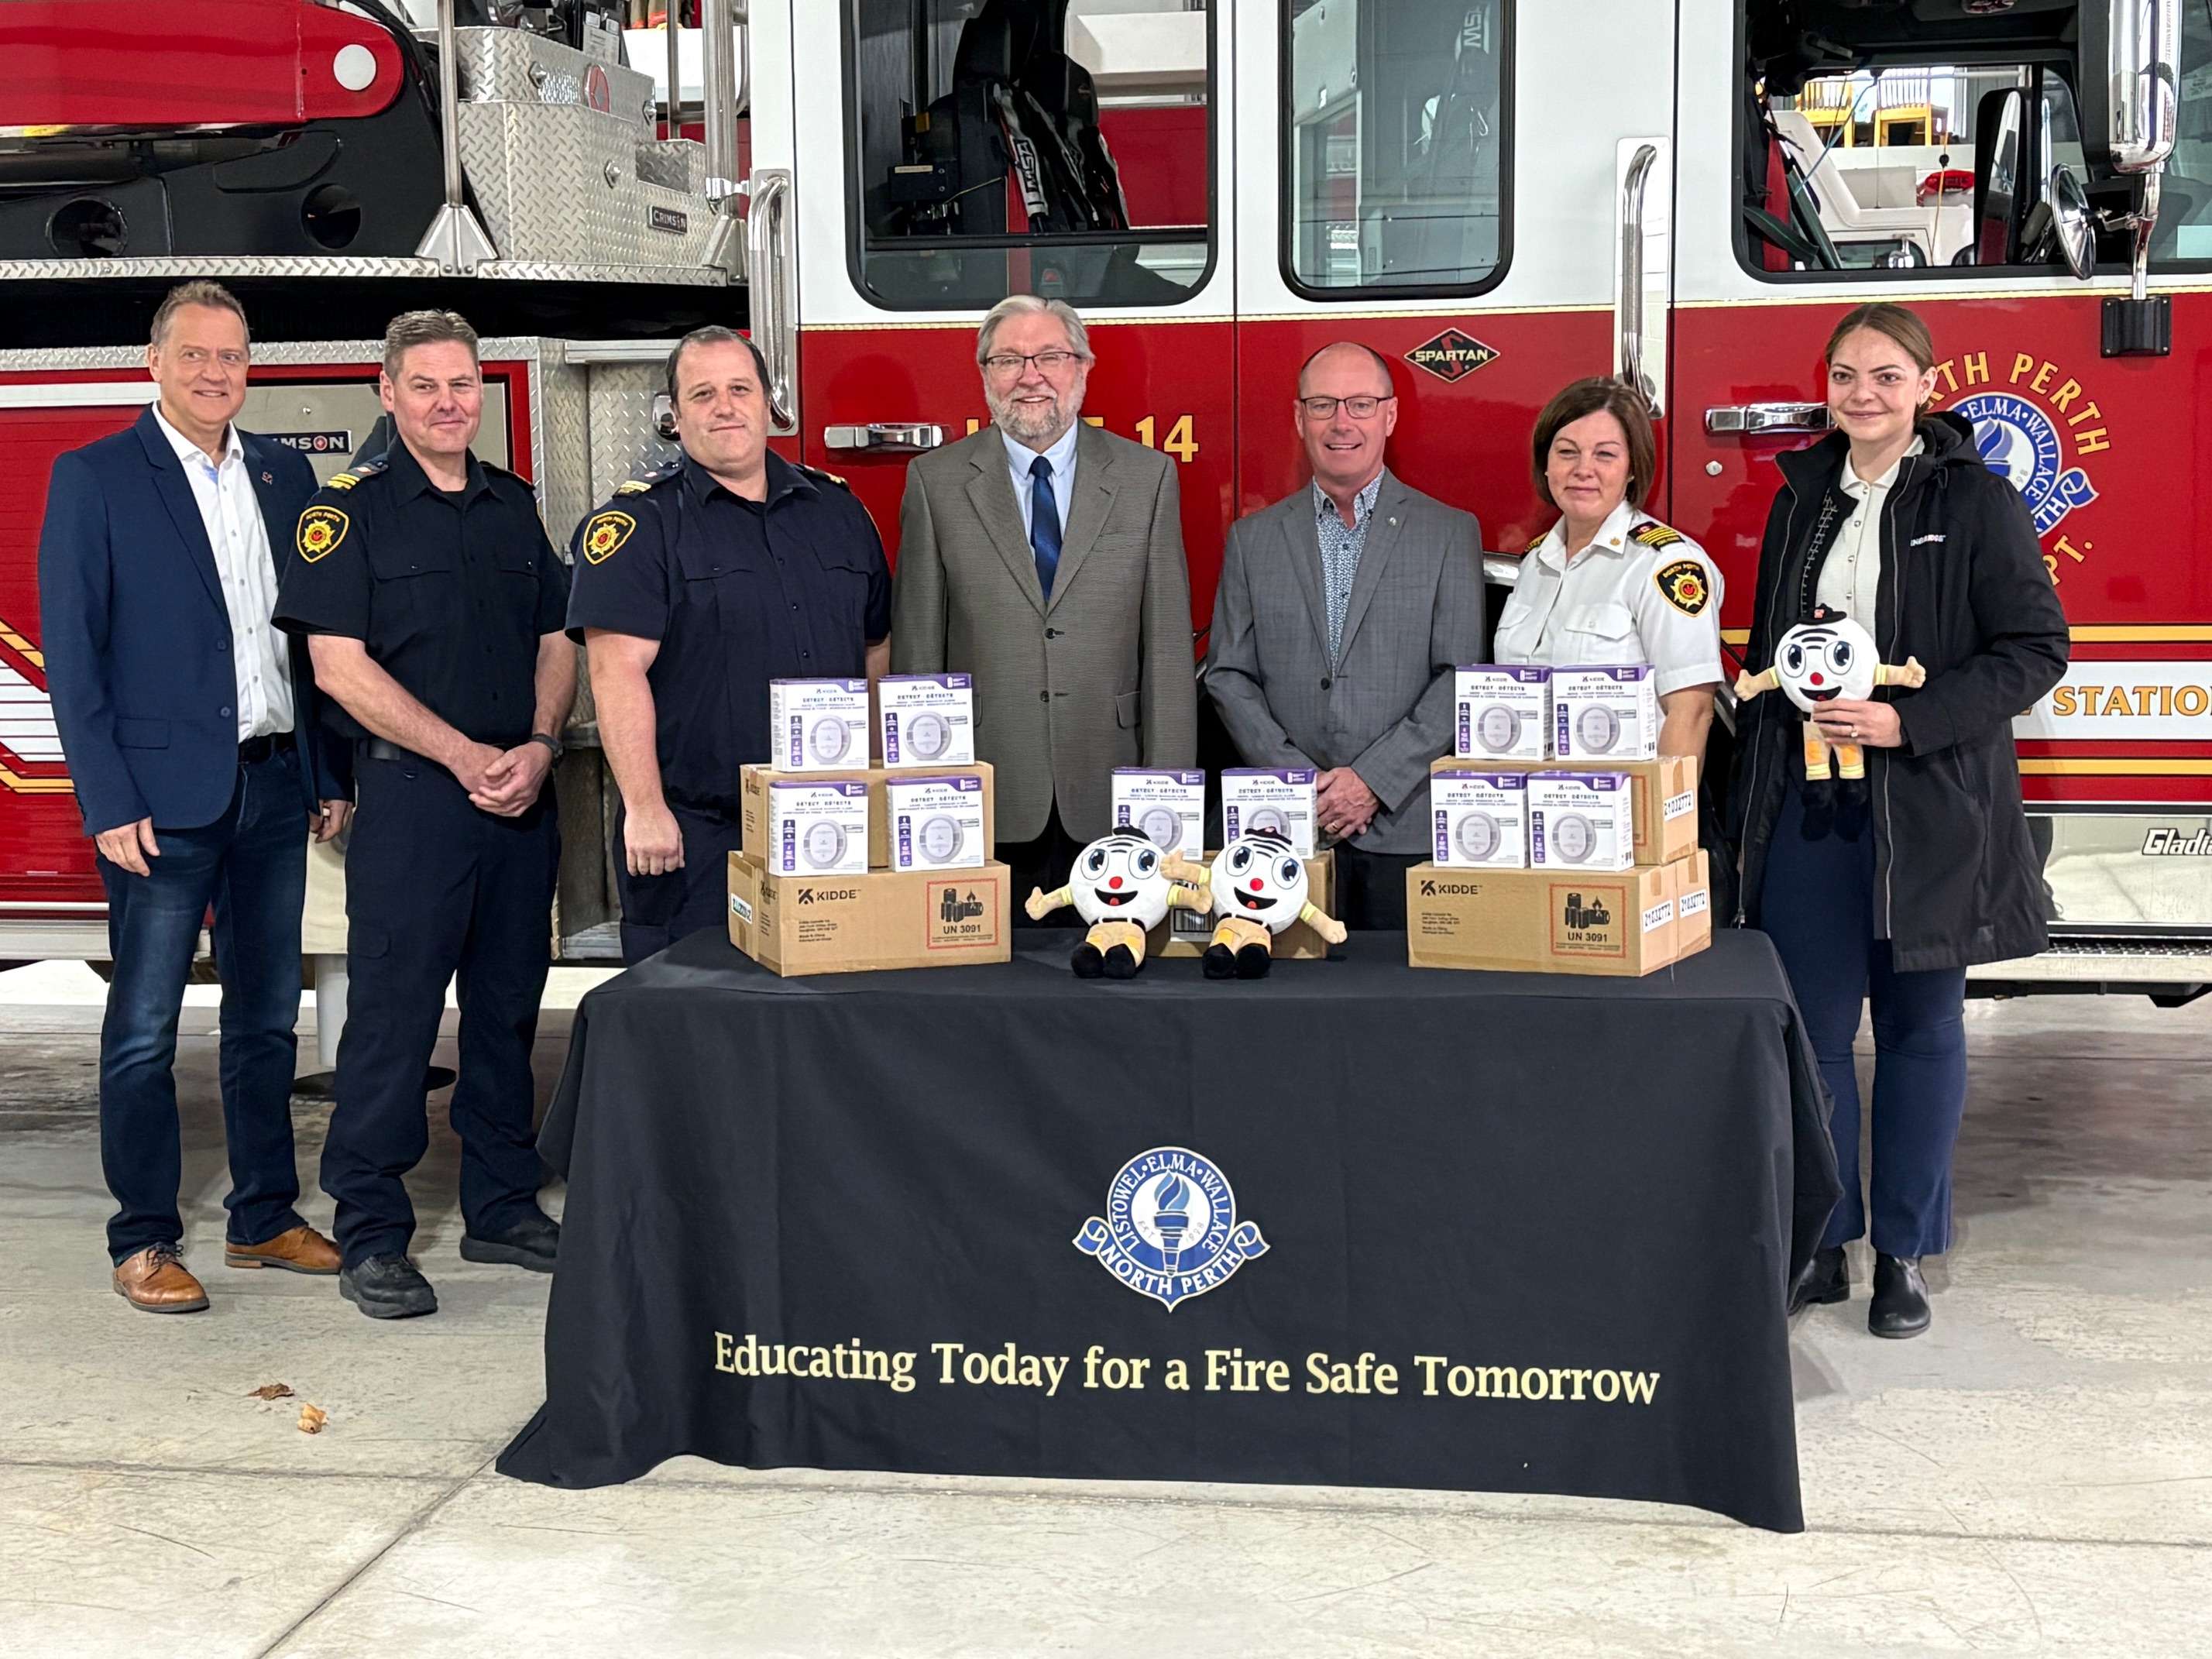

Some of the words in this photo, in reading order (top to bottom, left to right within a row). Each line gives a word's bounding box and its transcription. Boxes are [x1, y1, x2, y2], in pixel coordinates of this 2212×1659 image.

[1016, 140, 1039, 192] MSA
[1415, 349, 1488, 362] SPARTAN
[2009, 352, 2111, 456] PERTH
[1135, 415, 1198, 462] 14
[1966, 397, 2022, 421] ELMA
[2025, 412, 2056, 501] WALLACE
[2053, 685, 2212, 716] STATIO
[816, 889, 857, 902] KIDDE
[1438, 884, 1479, 895] KIDDE
[943, 925, 957, 934] UN
[960, 924, 981, 933] 3091
[1568, 932, 1582, 941] UN
[1585, 933, 1607, 943] 3091
[1111, 1167, 1146, 1252] LISTOWEL
[1146, 1153, 1197, 1178] ELMA
[1200, 1170, 1230, 1253] WALLACE
[1101, 1244, 1173, 1295] NORTH
[1181, 1247, 1241, 1294] PERTH
[714, 1331, 918, 1393] Educating
[931, 1342, 1070, 1396] Today
[1083, 1345, 1151, 1390] for
[1164, 1358, 1190, 1392] a
[1204, 1348, 1290, 1392] Fire
[1305, 1352, 1399, 1395] Safe
[1413, 1355, 1661, 1405] Tomorrow
